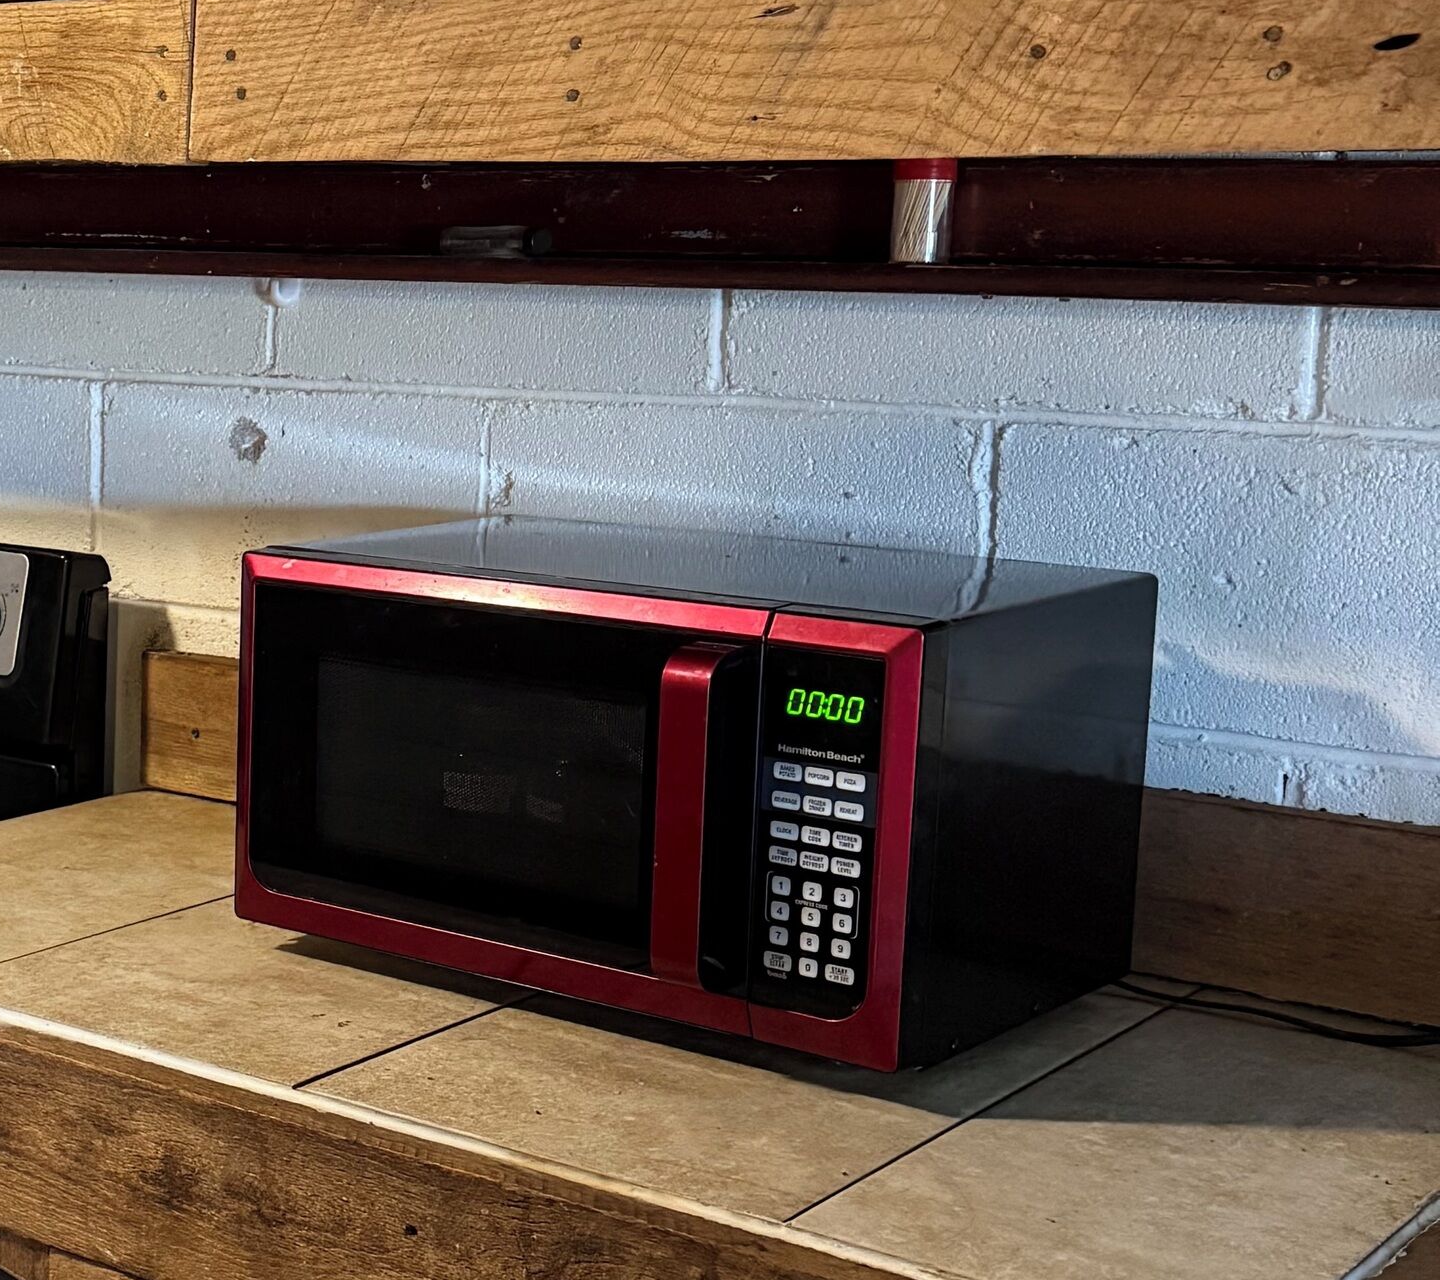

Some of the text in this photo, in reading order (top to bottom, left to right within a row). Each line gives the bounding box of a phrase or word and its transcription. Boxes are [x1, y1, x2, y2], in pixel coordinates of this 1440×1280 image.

[787, 688, 864, 724] 00:00
[777, 743, 826, 759] Hamilton
[776, 827, 792, 835] CLOCK
[809, 887, 815, 897] 2
[840, 893, 846, 902] 3
[776, 907, 783, 915] 4
[807, 912, 814, 921] 5
[839, 919, 845, 928] 6
[775, 931, 782, 940] 7
[806, 938, 812, 946] 8
[837, 944, 844, 953] 9
[805, 963, 811, 972] 0
